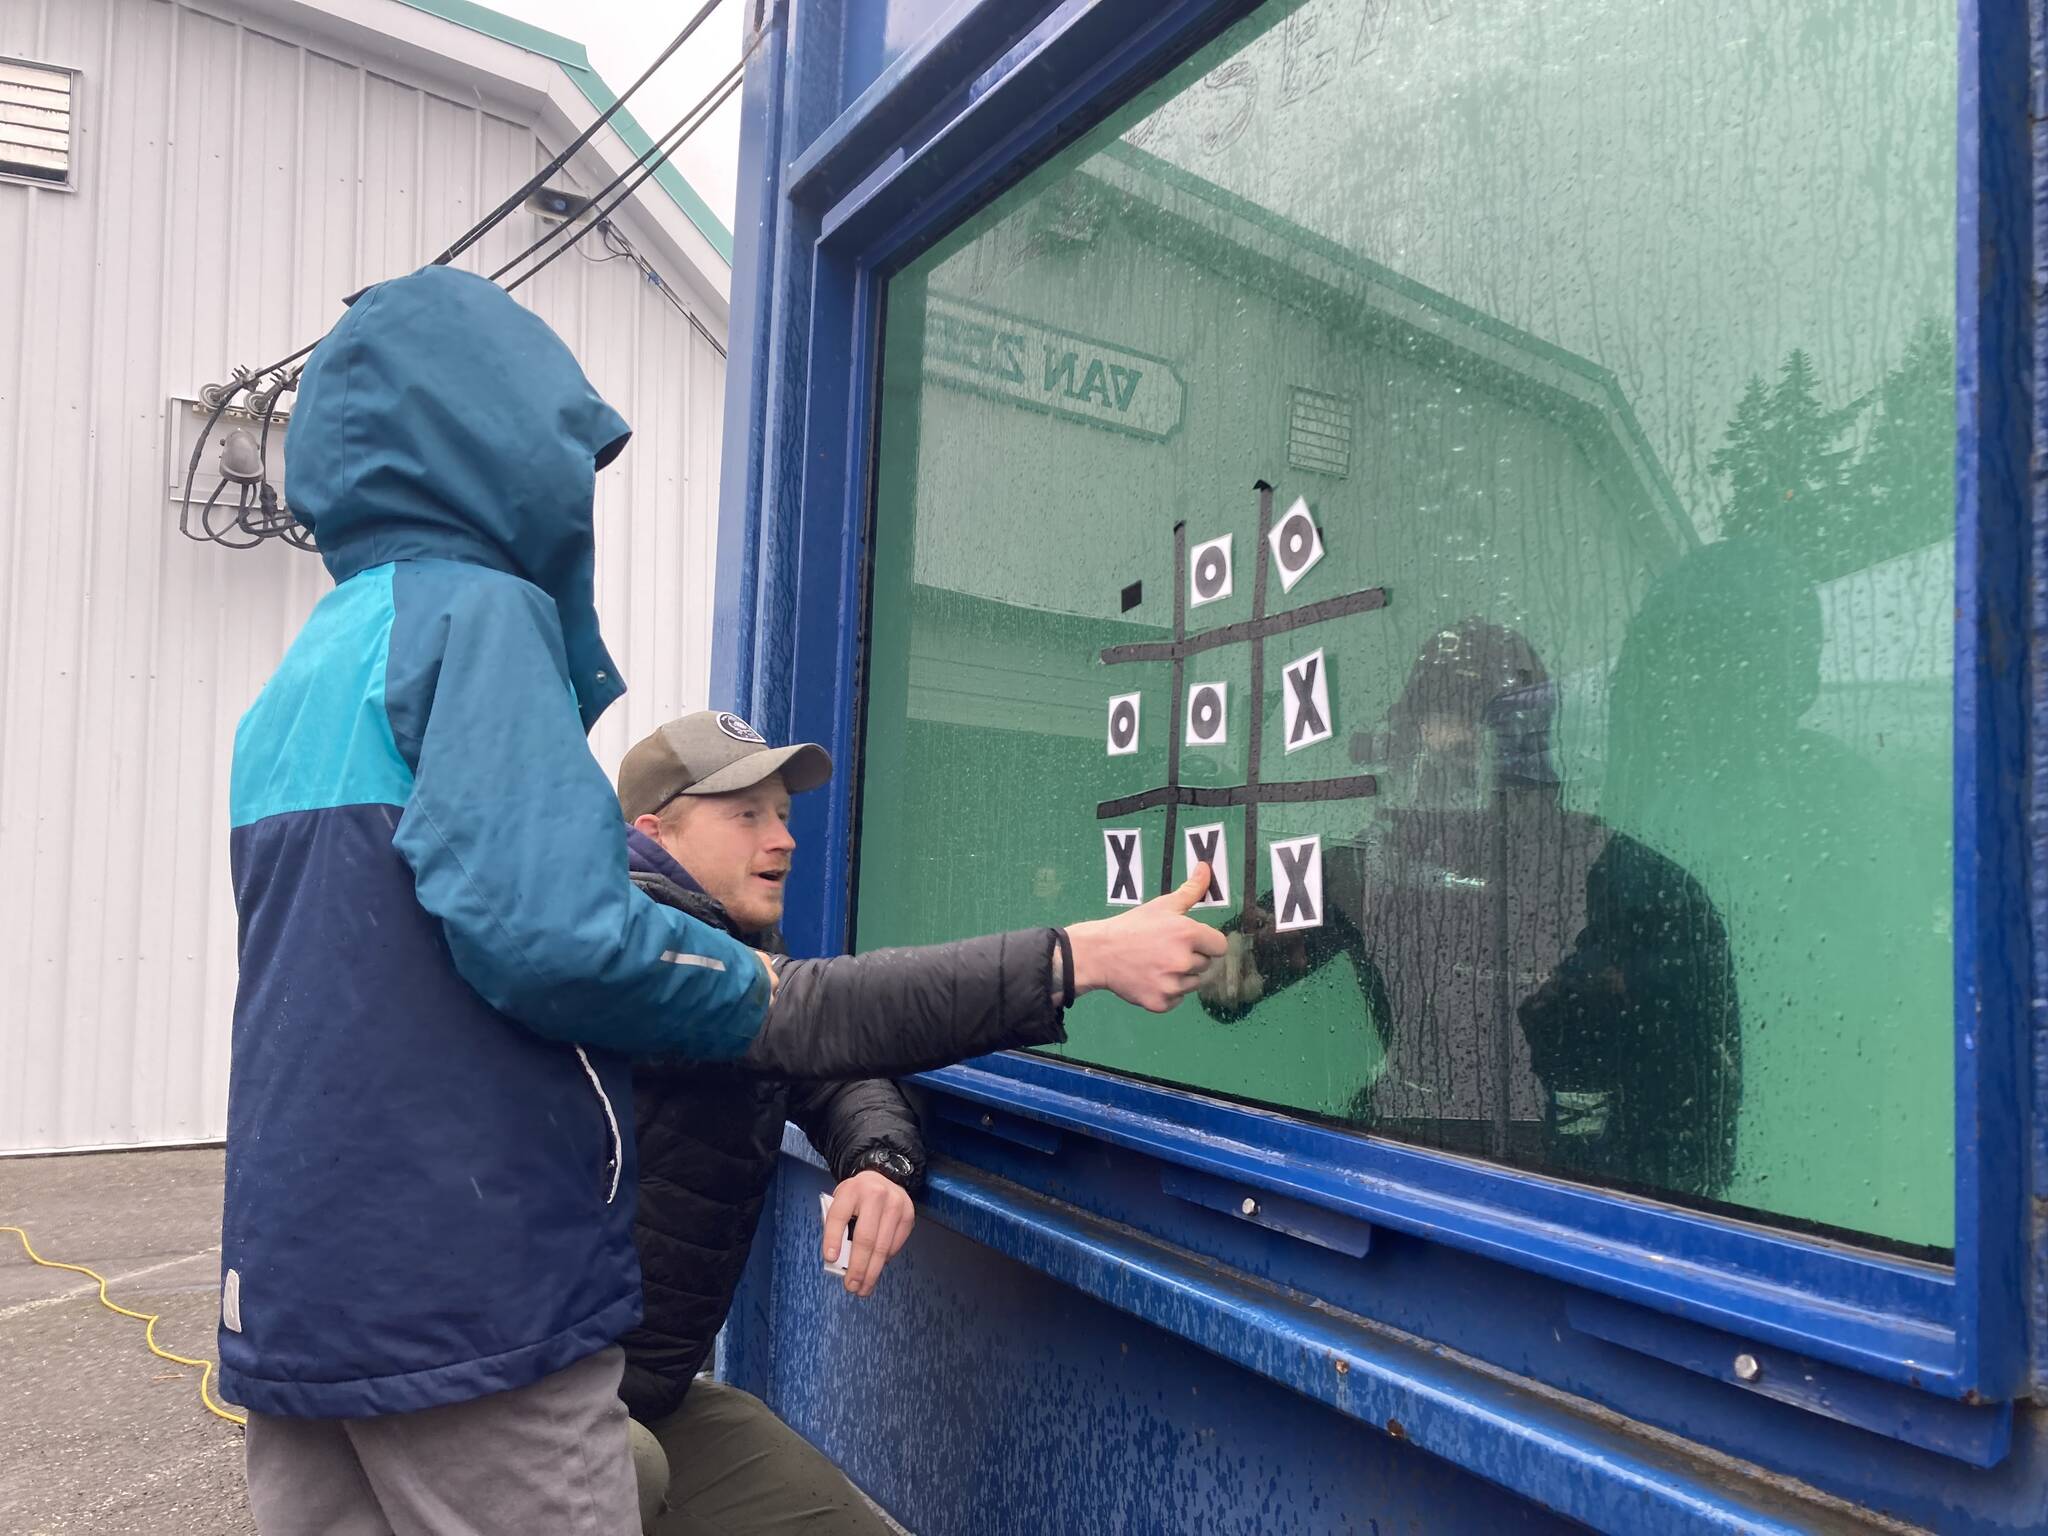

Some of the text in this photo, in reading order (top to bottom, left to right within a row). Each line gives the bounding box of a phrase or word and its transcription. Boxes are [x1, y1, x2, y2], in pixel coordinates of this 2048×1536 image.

[1195, 514, 1313, 599] O O
[1110, 657, 1327, 749] O O X
[1107, 830, 1318, 924] X X X
